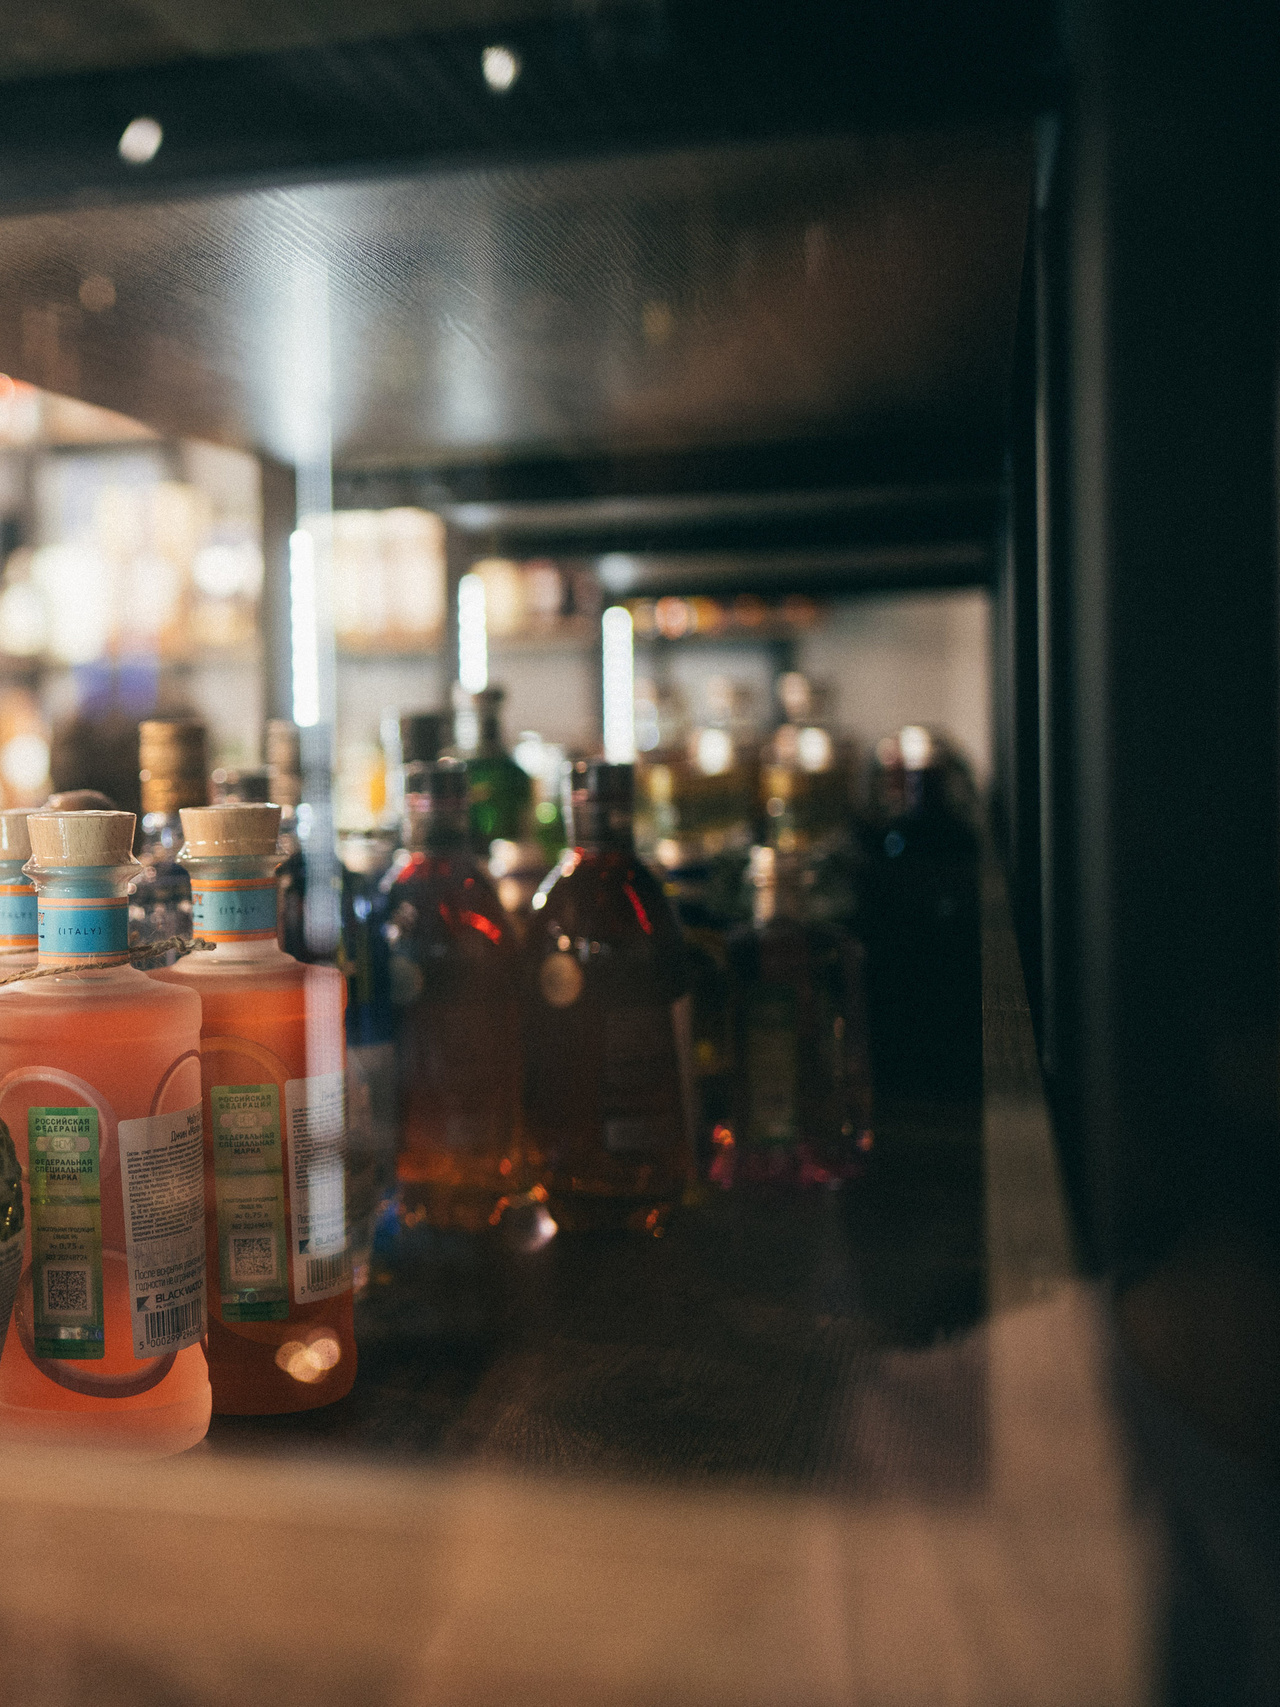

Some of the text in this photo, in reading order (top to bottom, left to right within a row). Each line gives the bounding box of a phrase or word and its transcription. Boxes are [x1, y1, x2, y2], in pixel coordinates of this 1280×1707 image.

[58, 927, 103, 936] (ITALY)
[218, 1094, 271, 1103] РОССИЙСКАЯ
[219, 1101, 271, 1110] ФЕДЕРАЦИЯ
[35, 1117, 90, 1126] РОССИЙСКАЯ
[35, 1125, 90, 1133] ФЕДЕРАЦИЯ
[219, 1132, 275, 1142] ФЕДЕРАЛЬНАЯ
[219, 1139, 275, 1148] СПЕЦИАЛЬНАЯ
[233, 1147, 261, 1155] МАРКА
[35, 1158, 93, 1166] ФЕДЕРАЛЬНАЯ
[134, 1269, 156, 1280] После
[135, 1280, 166, 1292] годности
[156, 1277, 204, 1303] BLACK WATCH
[301, 1285, 306, 1295] 5
[139, 1341, 145, 1351] 5
